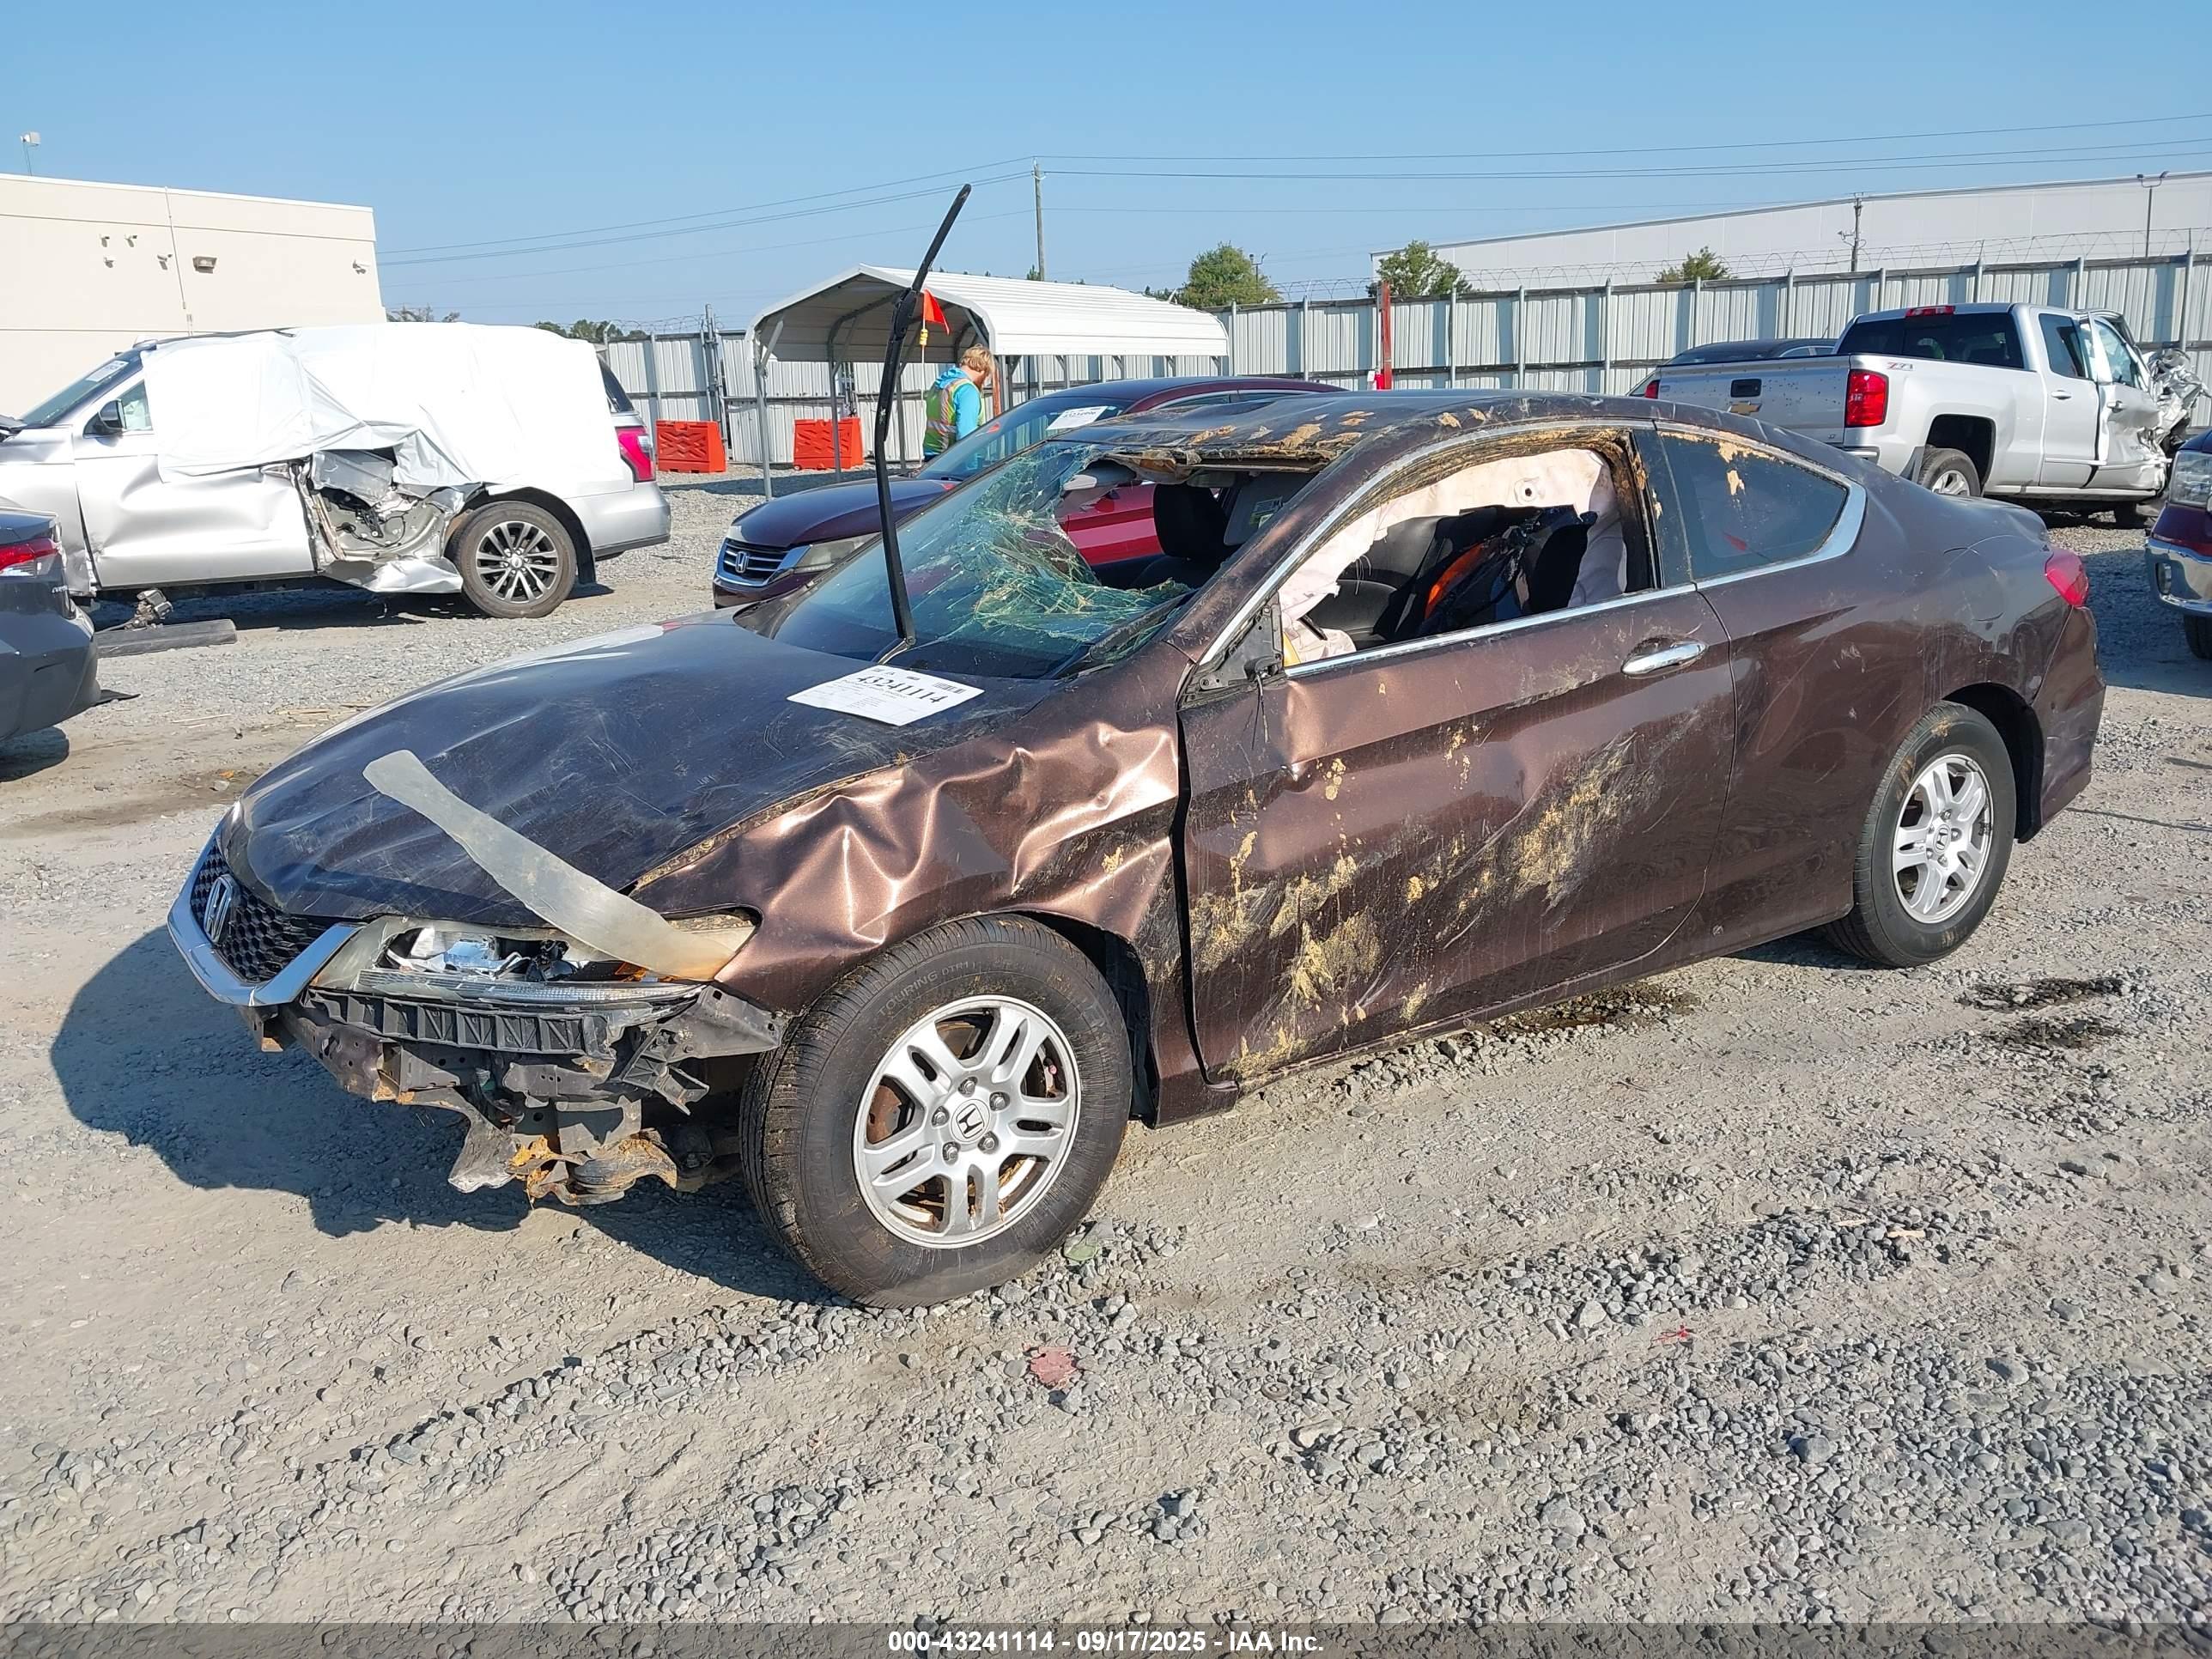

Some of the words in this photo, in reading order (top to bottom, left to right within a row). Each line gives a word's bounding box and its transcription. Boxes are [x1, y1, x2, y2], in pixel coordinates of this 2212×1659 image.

[1887, 362, 1914, 372] Z71
[856, 675, 949, 703] 43241114
[878, 969, 939, 1017] TOURING
